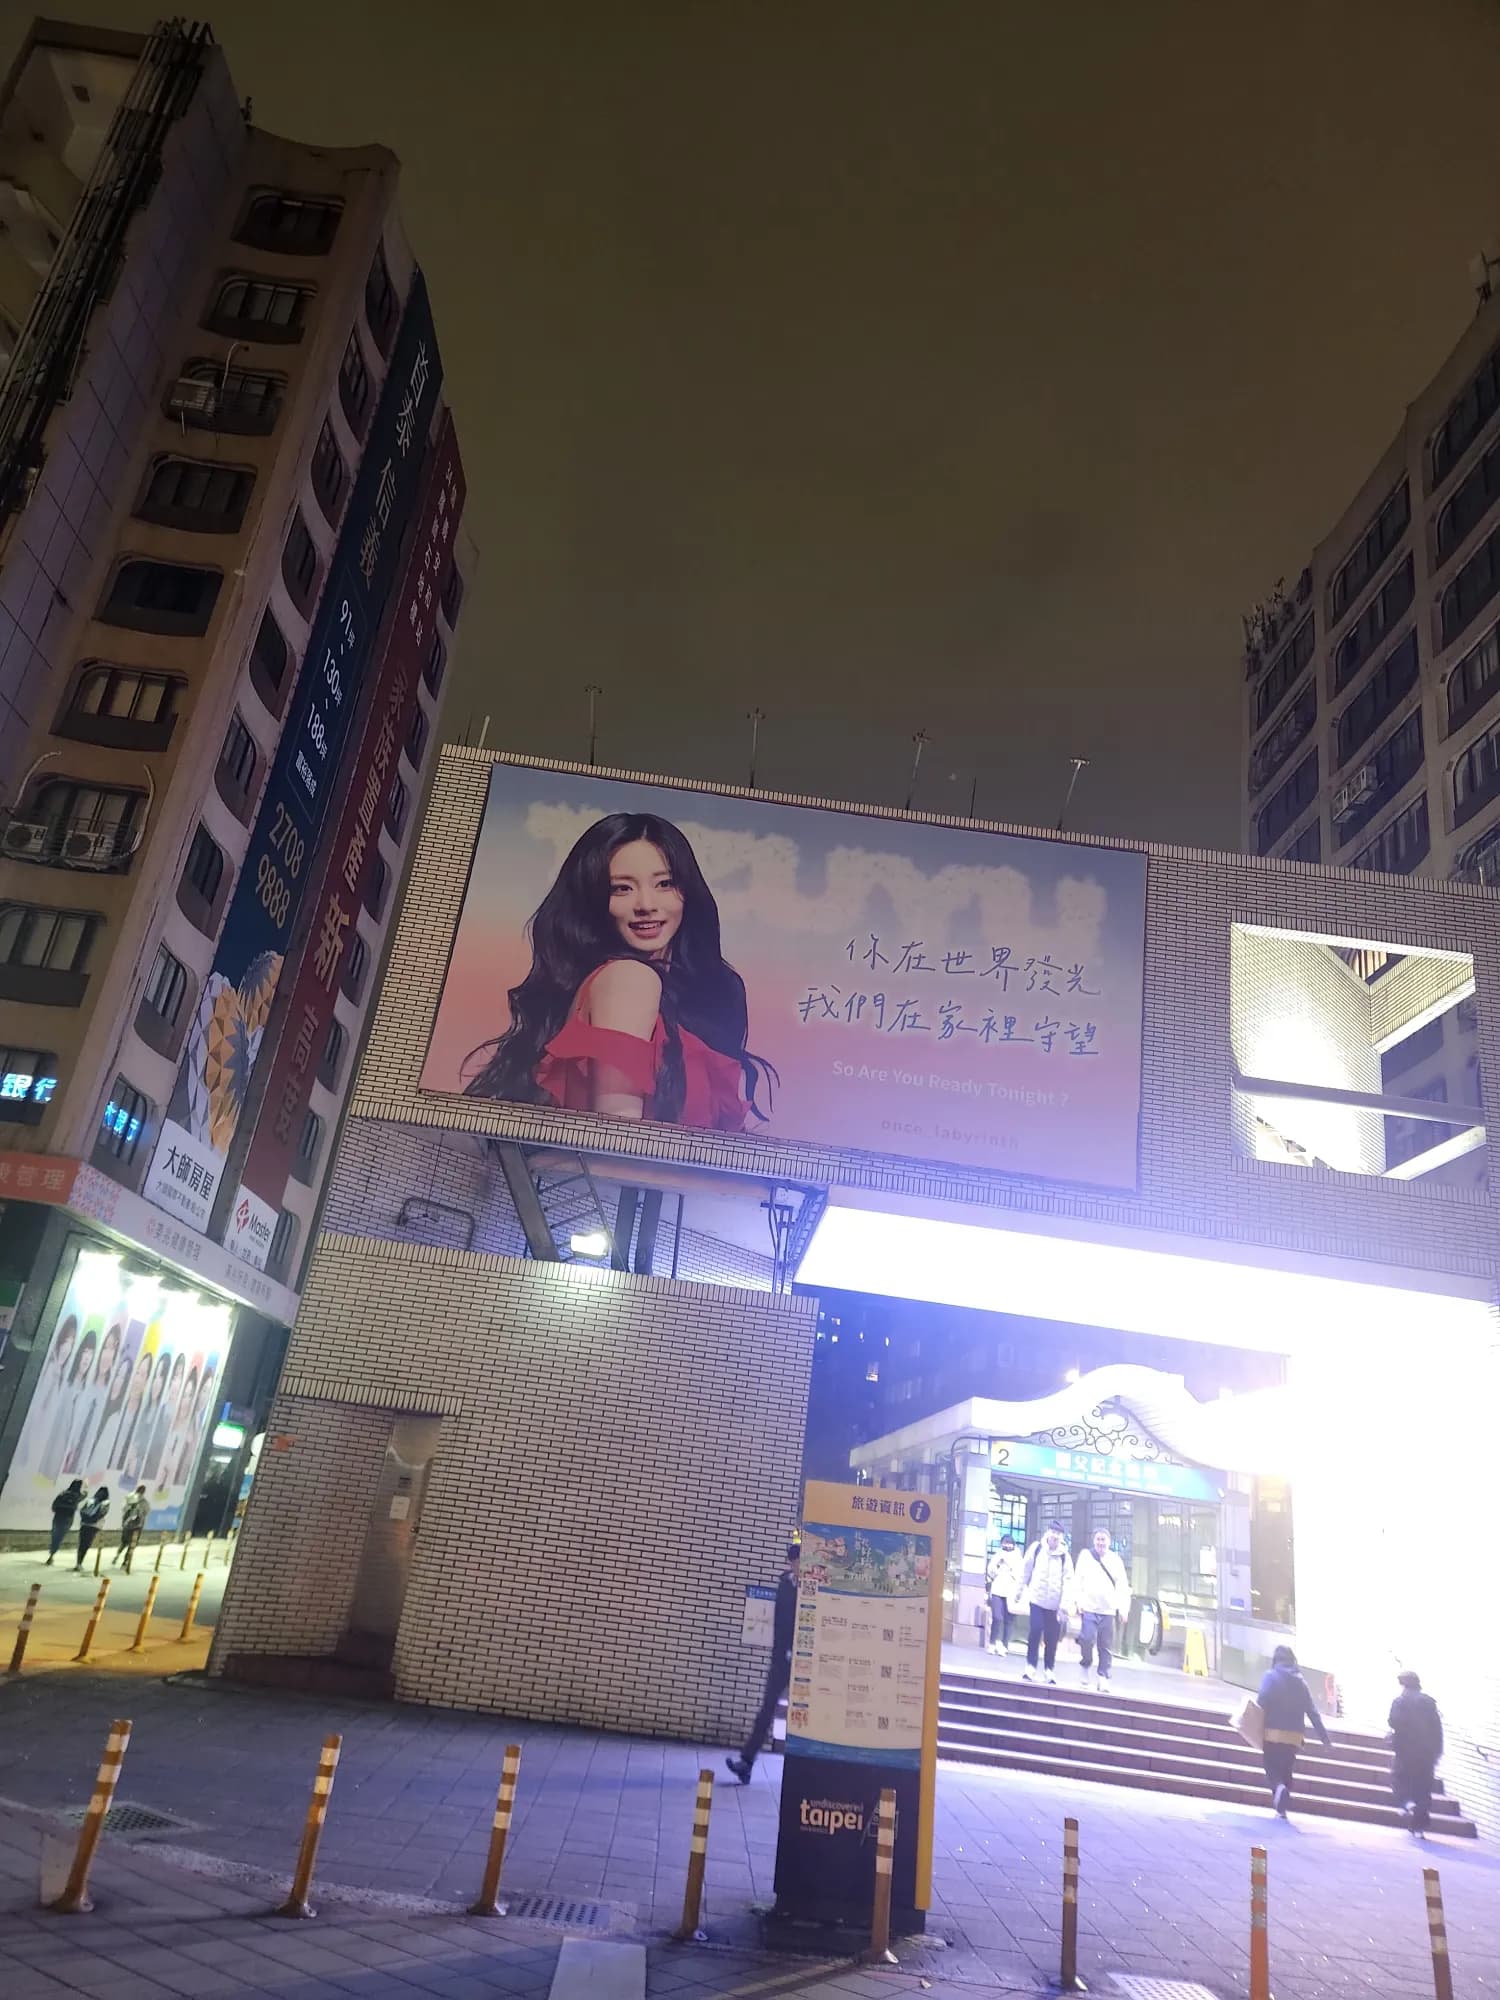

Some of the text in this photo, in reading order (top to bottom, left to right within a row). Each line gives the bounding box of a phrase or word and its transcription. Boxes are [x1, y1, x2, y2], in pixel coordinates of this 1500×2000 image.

[269, 801, 305, 880] 2708
[256, 853, 290, 929] 9888
[846, 933, 1102, 997] 你在世界發光
[798, 984, 1100, 1057] 我們在家裡守望
[832, 1060, 854, 1078] So
[857, 1063, 889, 1082] Are
[892, 1068, 924, 1088] You
[928, 1073, 984, 1098] Ready
[988, 1080, 1056, 1107] Tonight
[162, 1145, 215, 1201] 大師房屋
[249, 1213, 271, 1242] Master
[998, 1448, 1010, 1466] 2
[852, 1496, 905, 1517] 旅遊資訊
[800, 1798, 863, 1835] taipei
